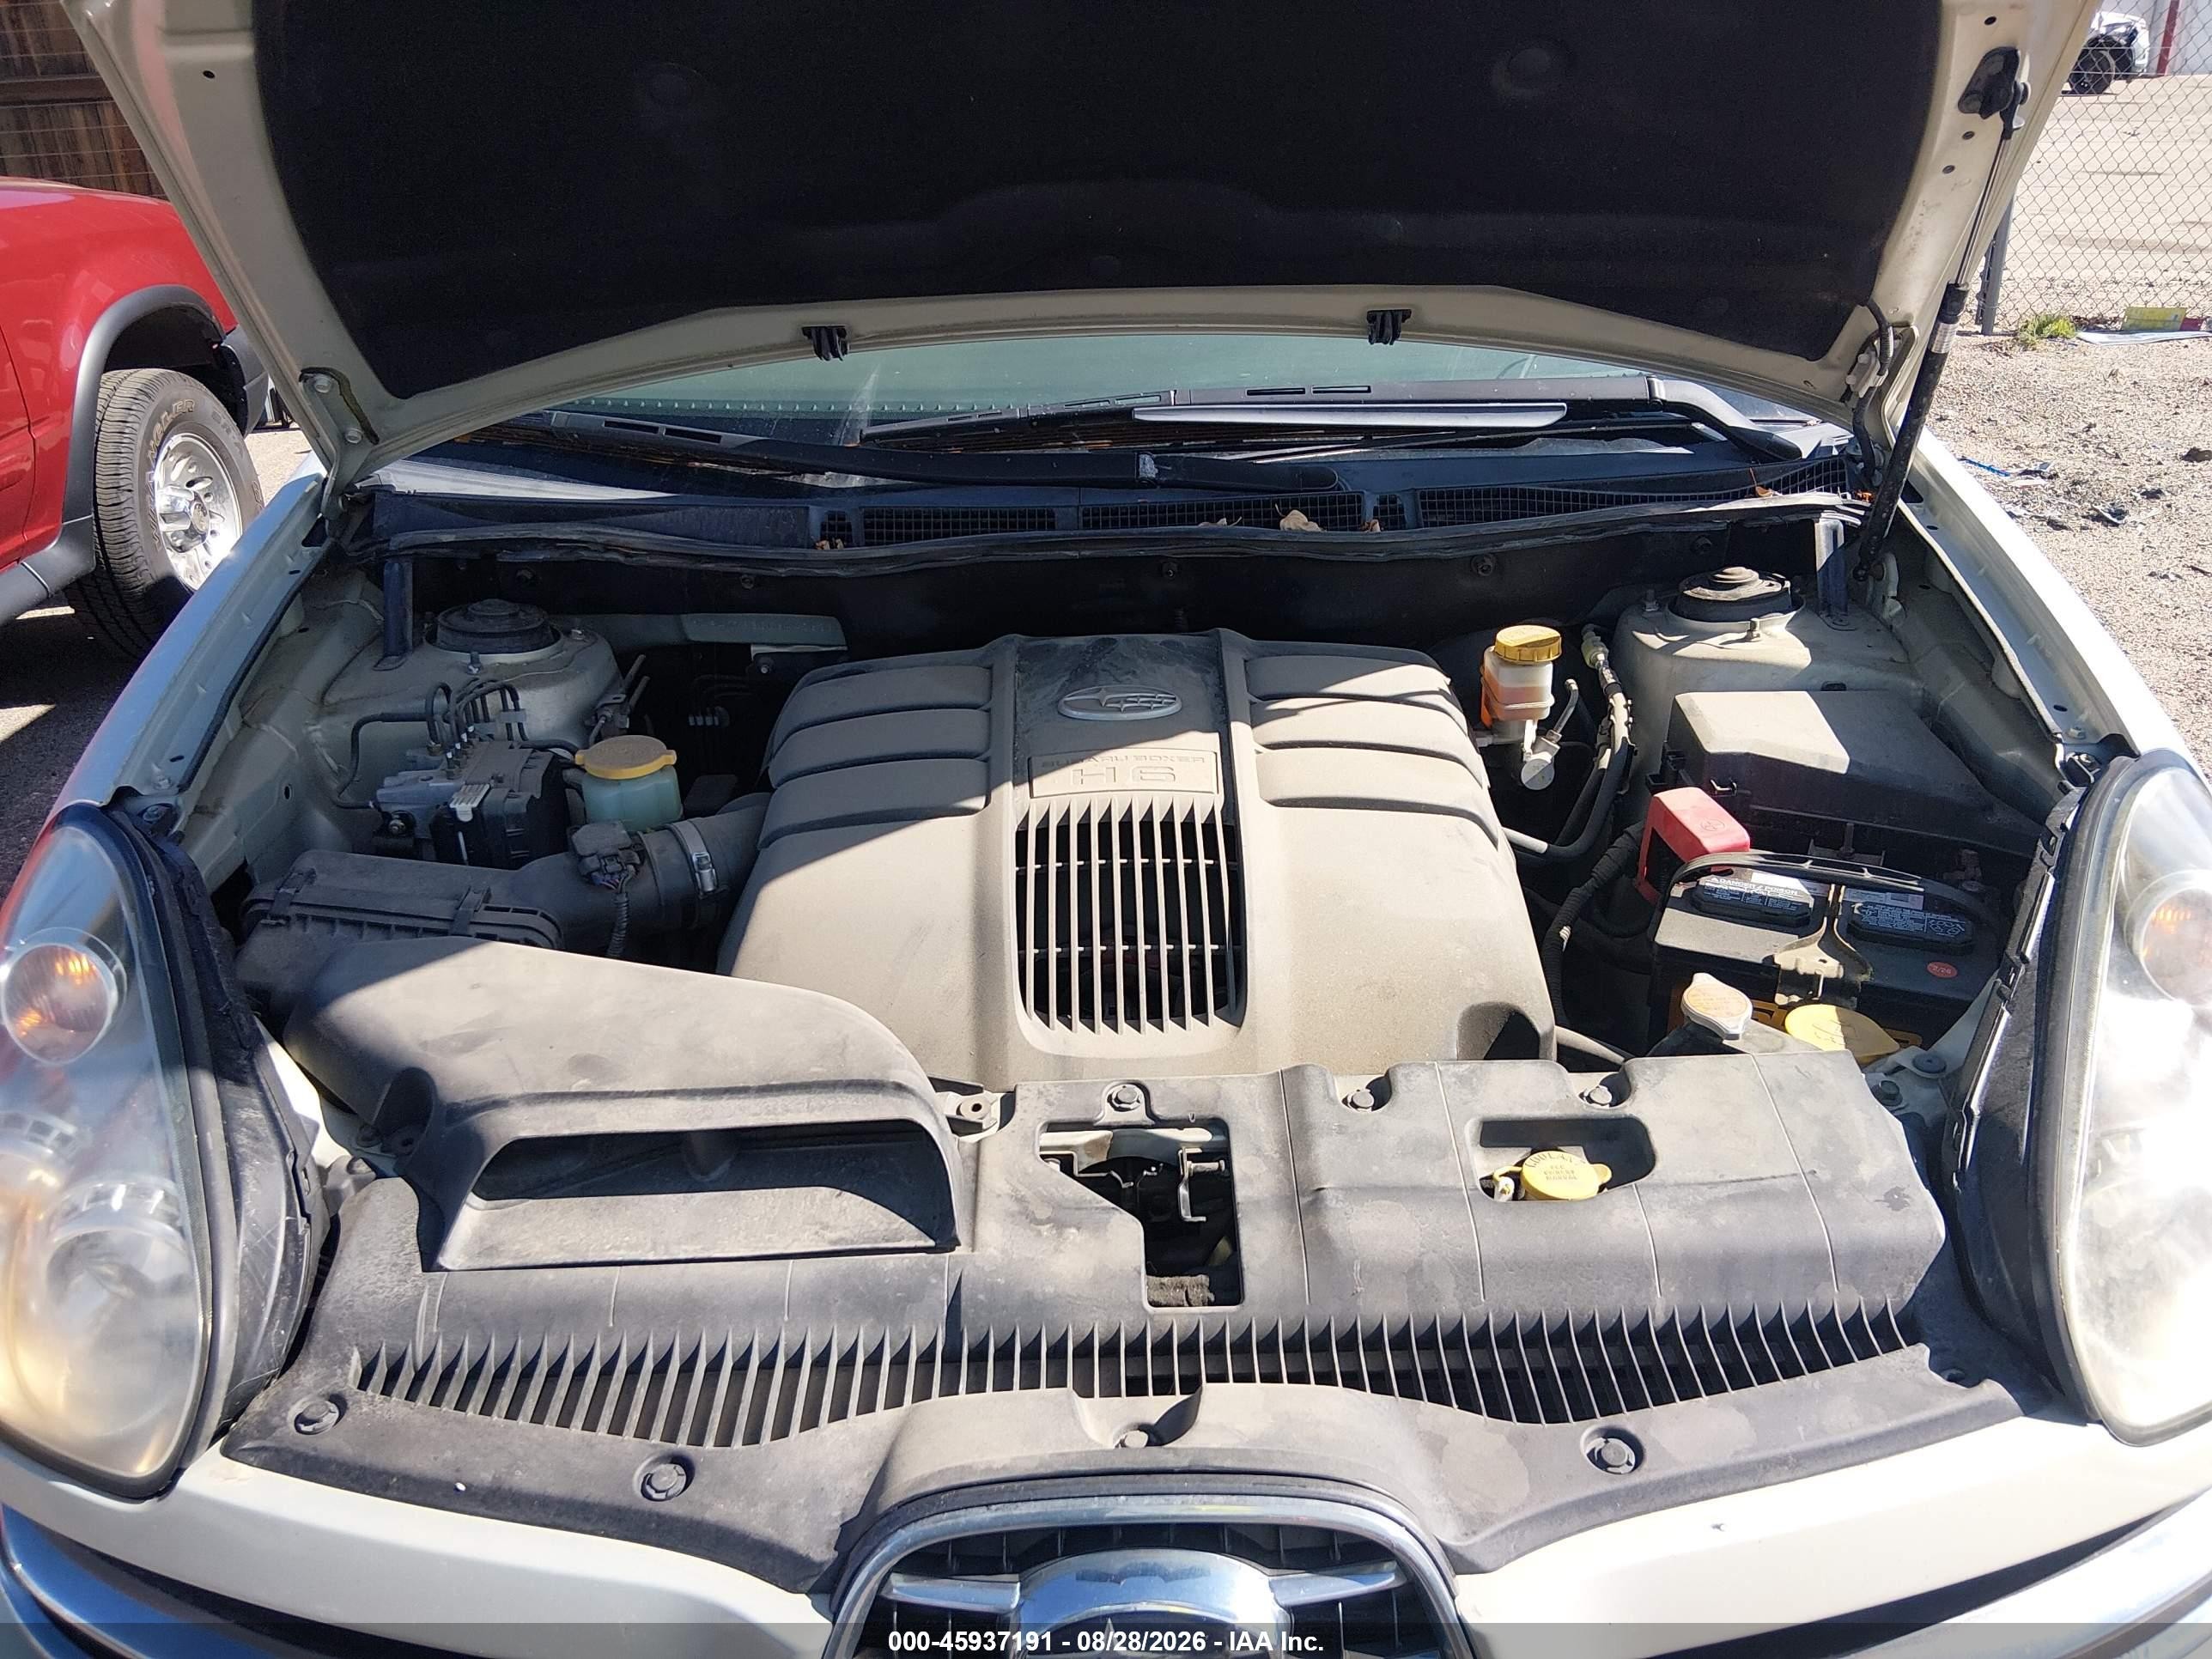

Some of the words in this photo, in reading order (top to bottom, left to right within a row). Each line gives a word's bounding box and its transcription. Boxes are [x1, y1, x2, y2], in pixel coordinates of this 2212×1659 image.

[1041, 754, 1128, 768] SUBARU
[1132, 753, 1206, 763] BOXER
[1072, 766, 1176, 786] H6
[1718, 878, 1756, 890] DANGER
[1764, 885, 1798, 896] POISON
